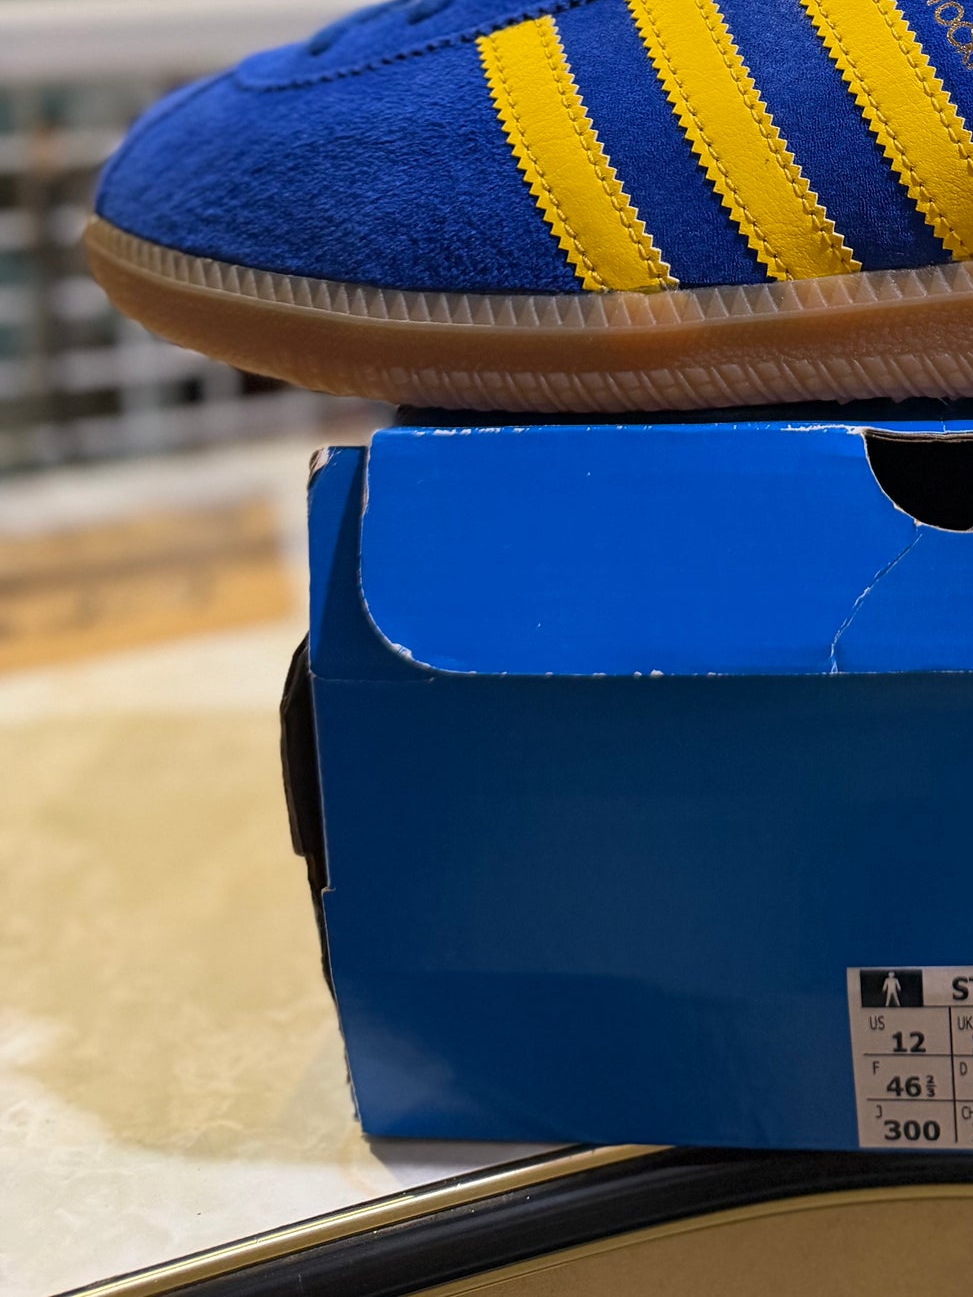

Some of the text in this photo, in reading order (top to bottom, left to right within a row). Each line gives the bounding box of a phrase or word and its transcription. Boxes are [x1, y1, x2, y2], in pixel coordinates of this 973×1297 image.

[869, 1015, 886, 1030] US
[957, 1015, 973, 1030] UK
[892, 1031, 927, 1053] 12
[872, 1060, 880, 1075] F
[959, 1061, 968, 1076] D
[875, 1104, 883, 1119] J
[883, 1119, 941, 1141] 300
